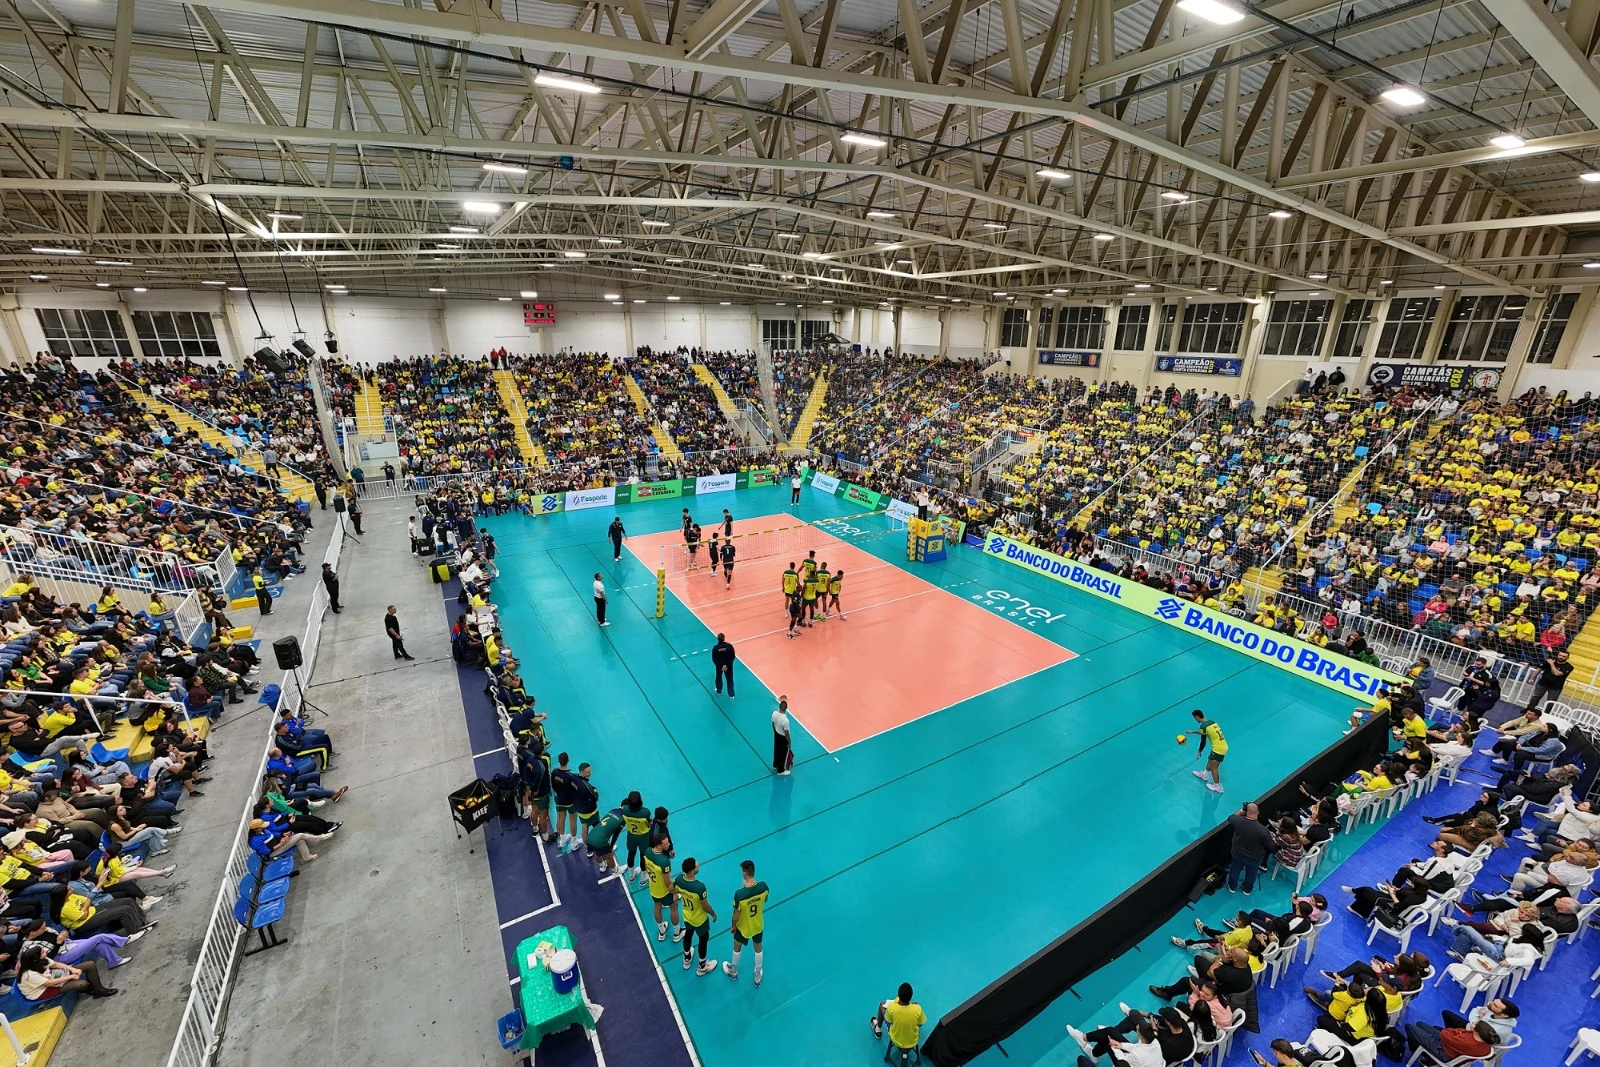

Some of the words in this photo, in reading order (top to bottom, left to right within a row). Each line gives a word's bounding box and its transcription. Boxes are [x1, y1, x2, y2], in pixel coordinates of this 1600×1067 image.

[1174, 358, 1209, 366] CAMPEÃO
[1403, 367, 1453, 376] CAMPEÃS
[1401, 374, 1450, 383] CATARINENSE
[581, 494, 608, 503] Fesporte
[1006, 543, 1050, 571] BANCO
[1050, 562, 1070, 579] DO
[1070, 566, 1122, 599] BRASIL
[972, 594, 1037, 627] BRASIL
[986, 589, 1066, 624] enel
[1184, 608, 1260, 650] BANCO
[1260, 638, 1295, 663] DO
[472, 804, 489, 821] KIEF
[631, 823, 638, 833] 2
[682, 899, 694, 912] 10
[749, 904, 757, 918] 9
